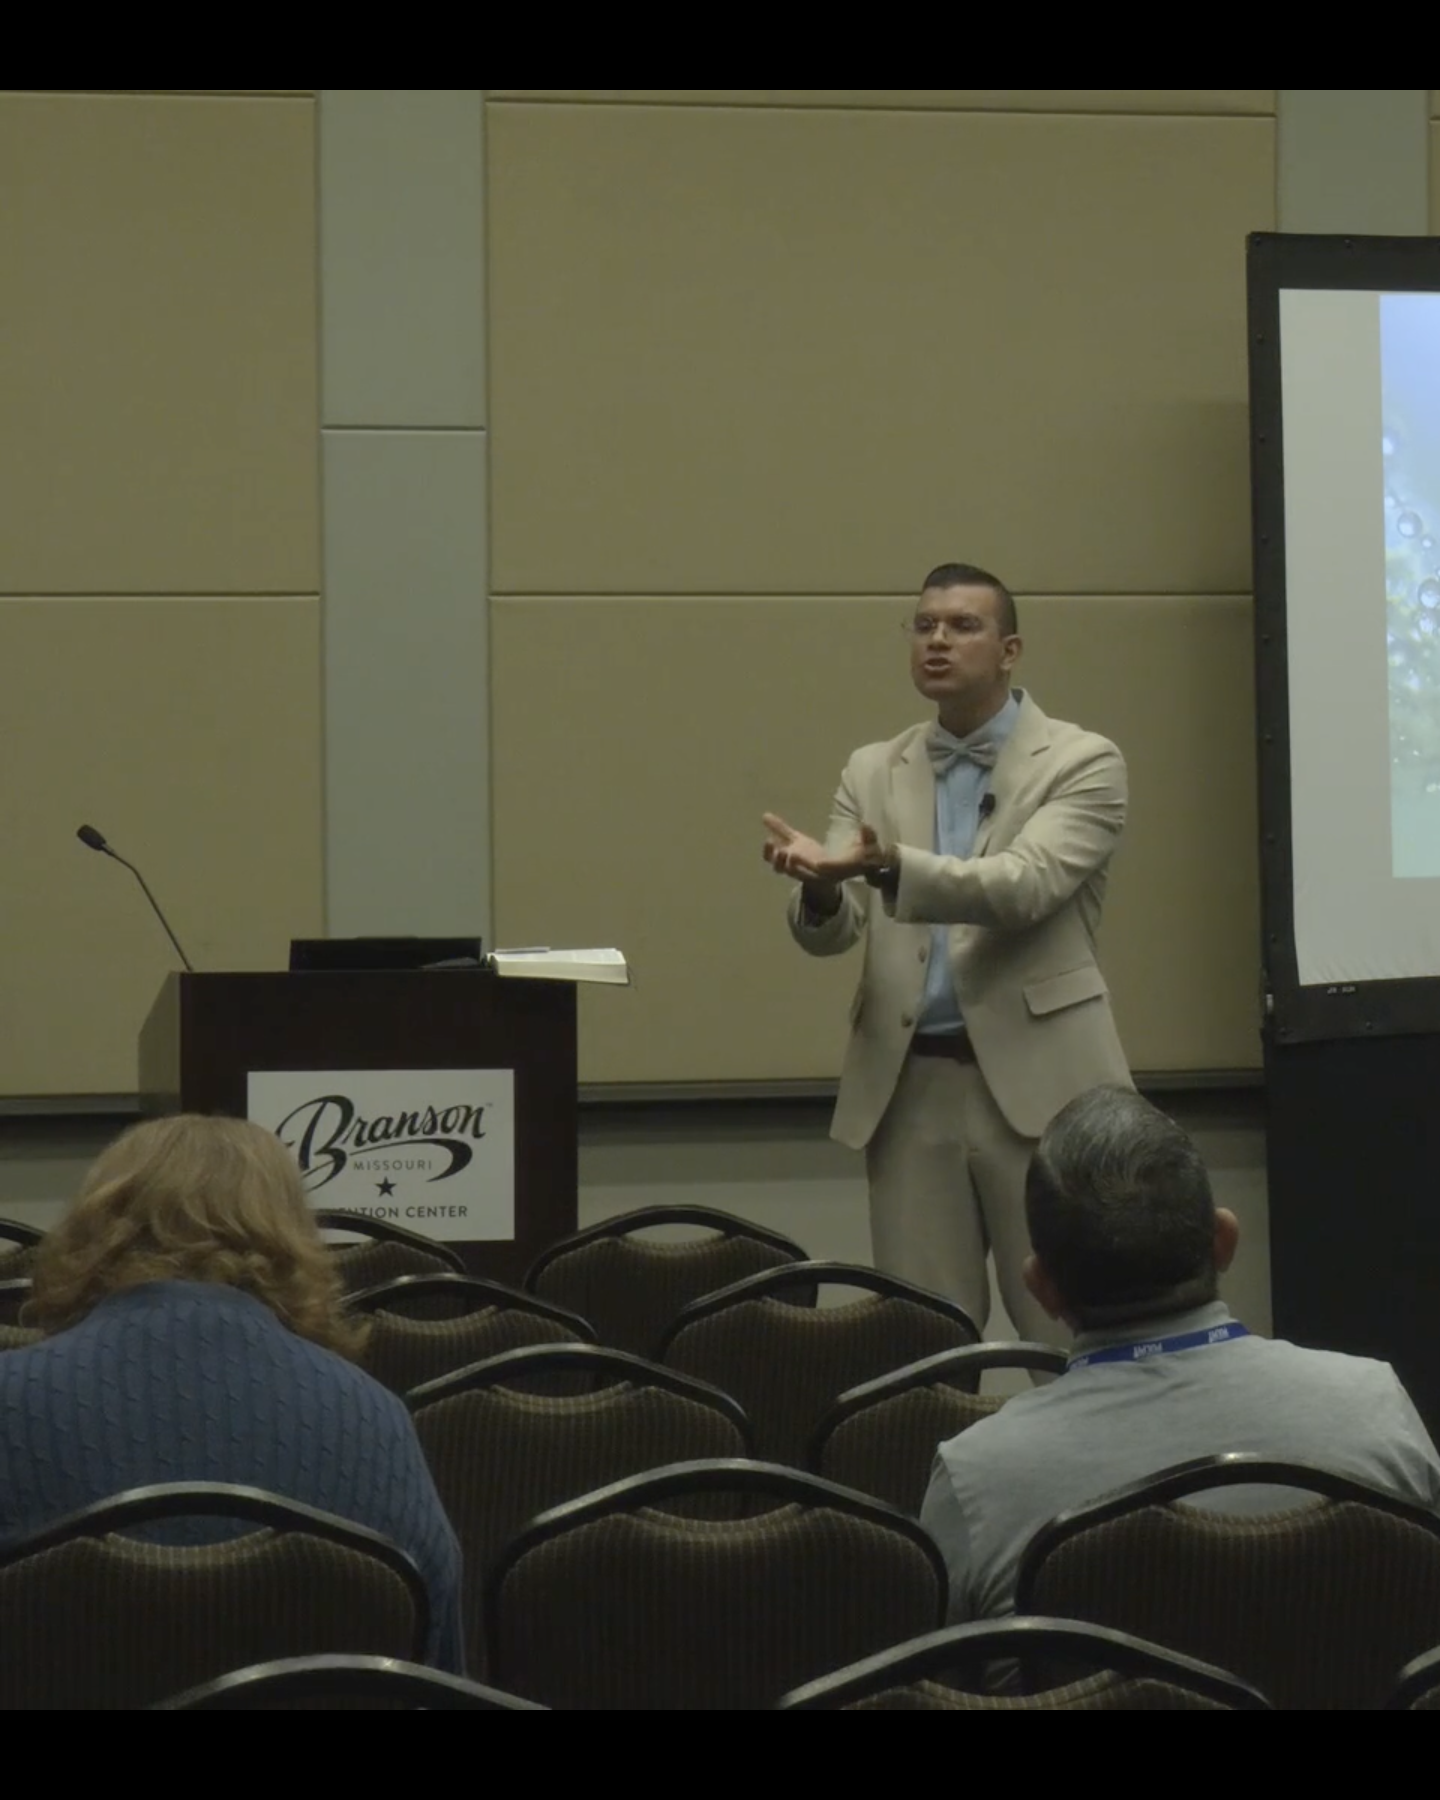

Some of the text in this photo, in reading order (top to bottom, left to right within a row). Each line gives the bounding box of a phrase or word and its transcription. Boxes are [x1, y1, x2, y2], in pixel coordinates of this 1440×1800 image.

[275, 1094, 487, 1192] Branson
[353, 1160, 433, 1171] MISSOURI
[406, 1206, 468, 1219] CENTER
